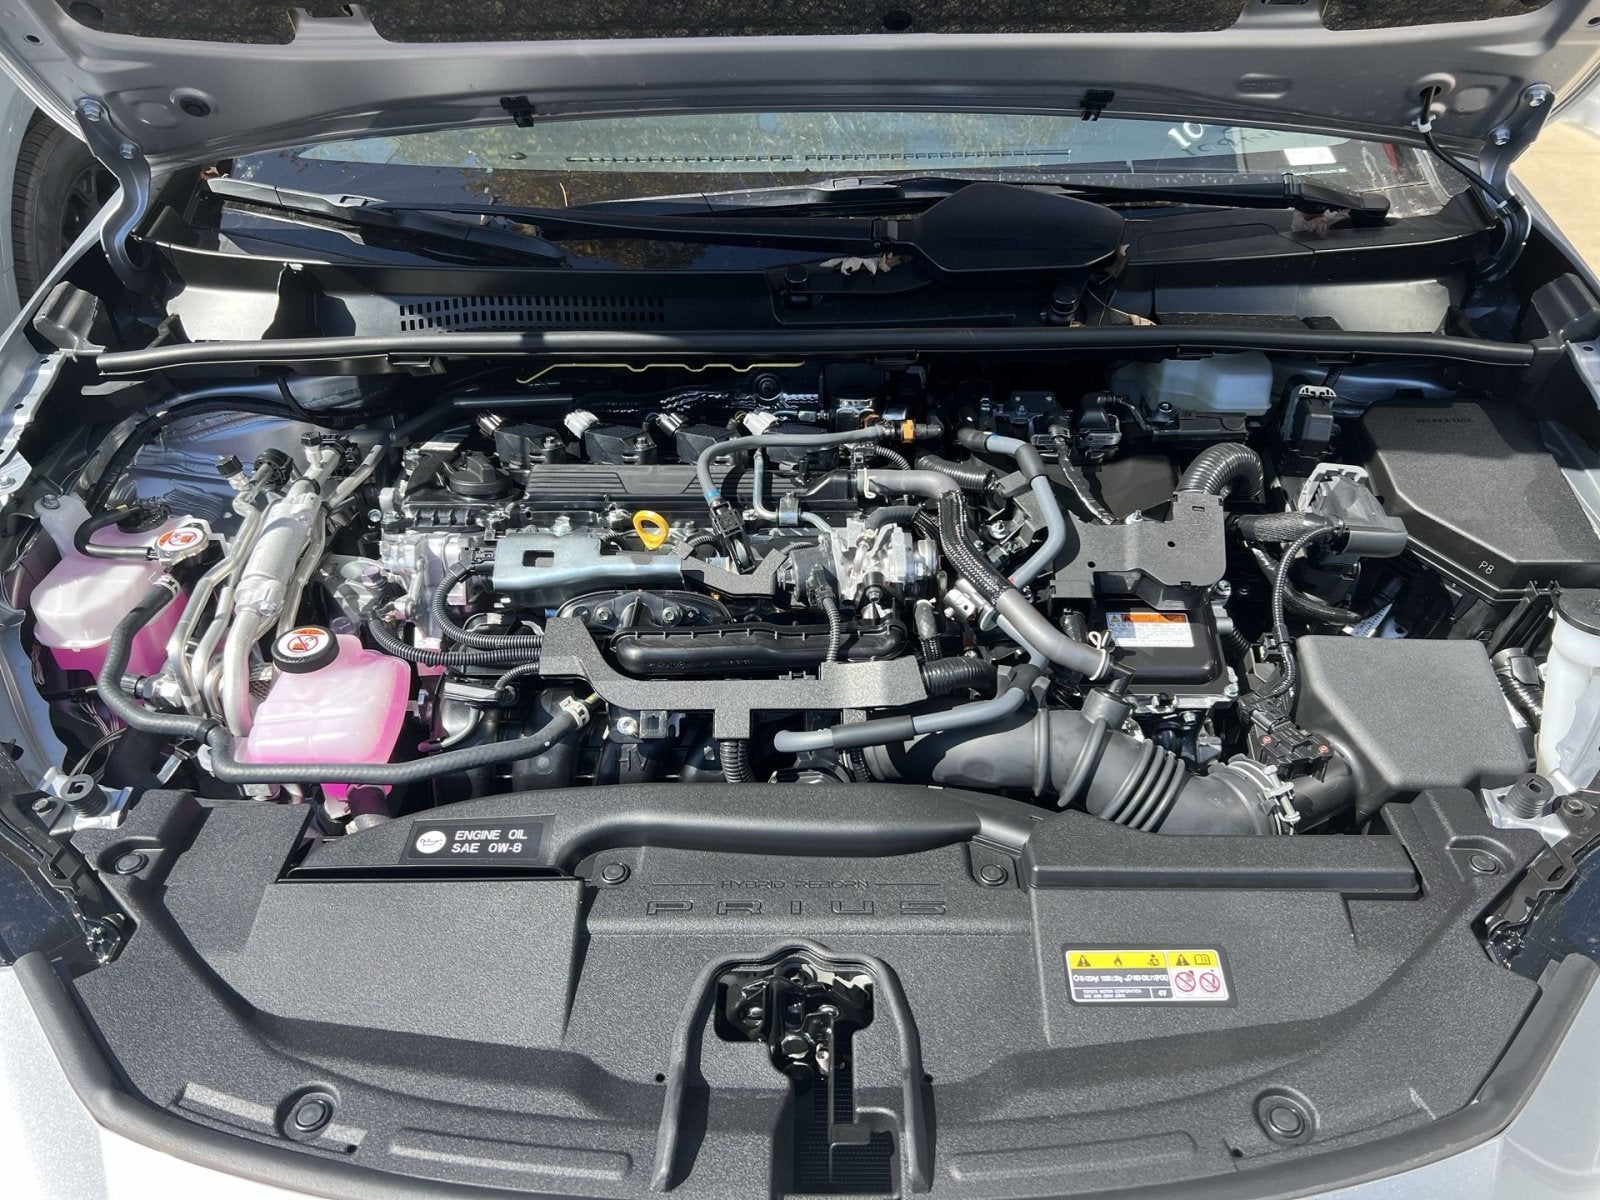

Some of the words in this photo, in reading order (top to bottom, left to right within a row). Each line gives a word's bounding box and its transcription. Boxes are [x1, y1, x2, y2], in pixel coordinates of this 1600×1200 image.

[455, 829, 501, 840] ENGINE
[508, 829, 528, 840] OIL
[451, 843, 480, 853] SAE
[721, 880, 785, 889] HYBRID
[795, 880, 868, 889] REBORN
[646, 899, 947, 915] PRIUS
